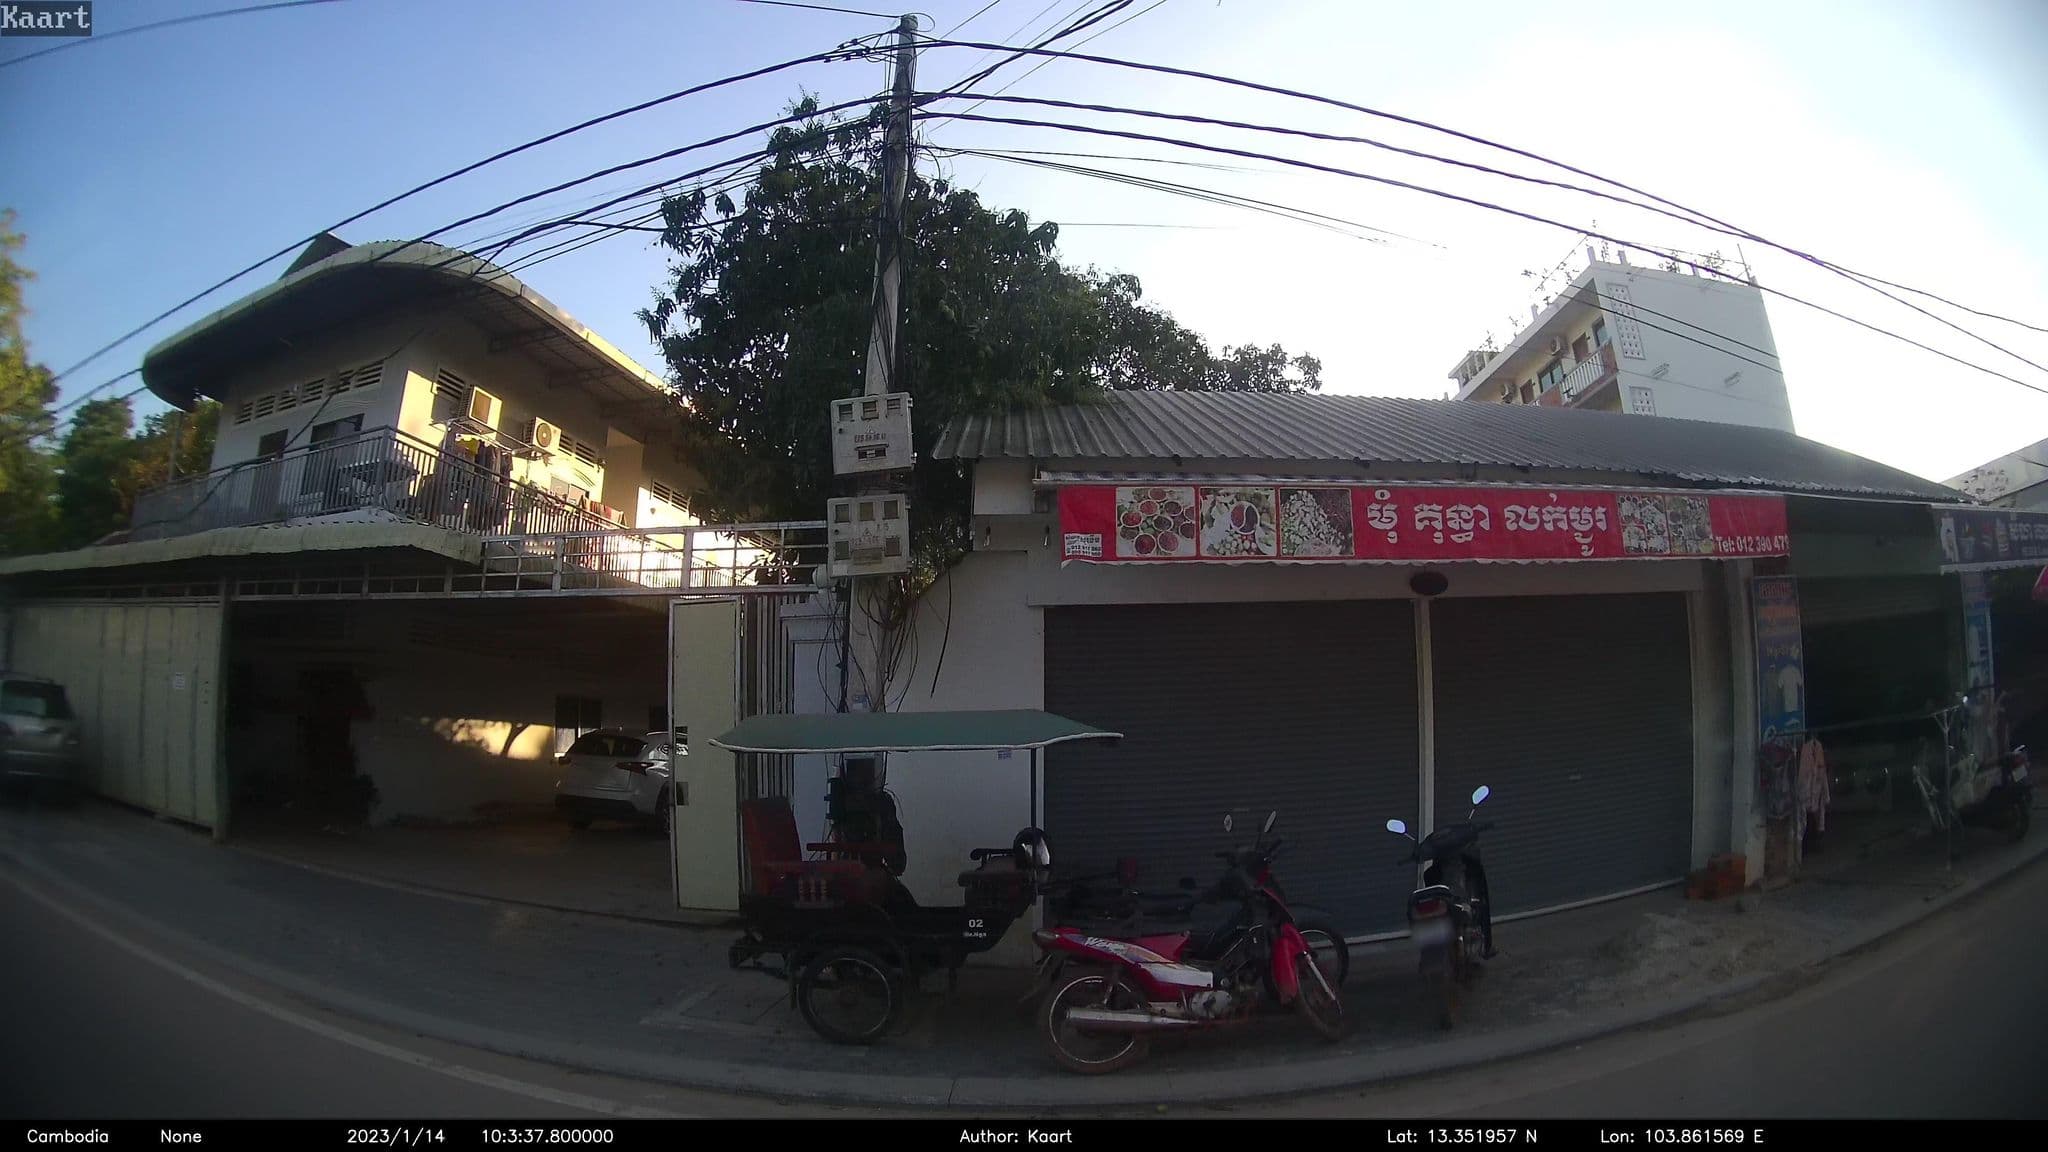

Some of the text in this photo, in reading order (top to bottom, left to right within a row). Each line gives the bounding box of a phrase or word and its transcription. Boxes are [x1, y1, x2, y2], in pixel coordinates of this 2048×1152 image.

[1716, 535, 1735, 552] Tel:
[1736, 535, 1754, 552] 012
[1756, 535, 1773, 552] 390
[968, 919, 984, 928] 02
